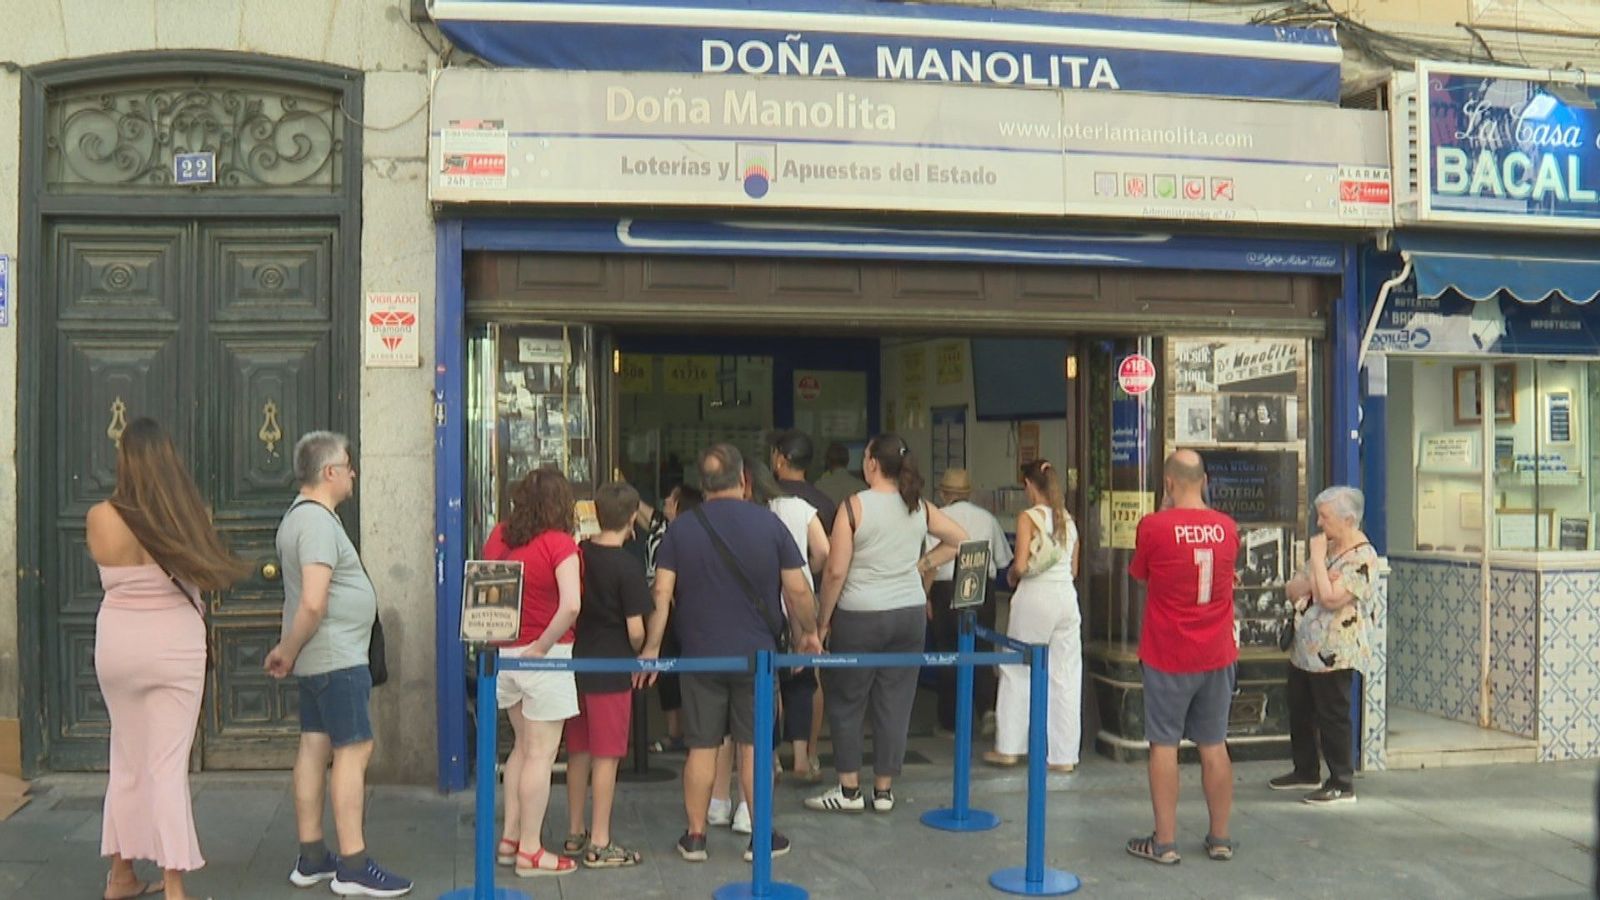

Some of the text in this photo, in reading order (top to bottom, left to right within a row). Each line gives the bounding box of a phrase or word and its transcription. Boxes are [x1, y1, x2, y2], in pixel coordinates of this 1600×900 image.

[701, 32, 1121, 90] DOÑA MANOLITA
[605, 85, 897, 131] Doña Manolita
[1454, 98, 1500, 142] La
[1509, 101, 1583, 148] Casa
[998, 119, 1254, 149] www.loteriamanolita.com
[181, 158, 208, 178] 22
[621, 156, 998, 187] Loterías y Apuestas del Estado
[1339, 169, 1390, 180] ALARMA
[1436, 146, 1597, 203] BACAL
[368, 295, 417, 305] VIGILADO
[1174, 523, 1226, 545] PEDRO
[1193, 547, 1215, 606] 1
